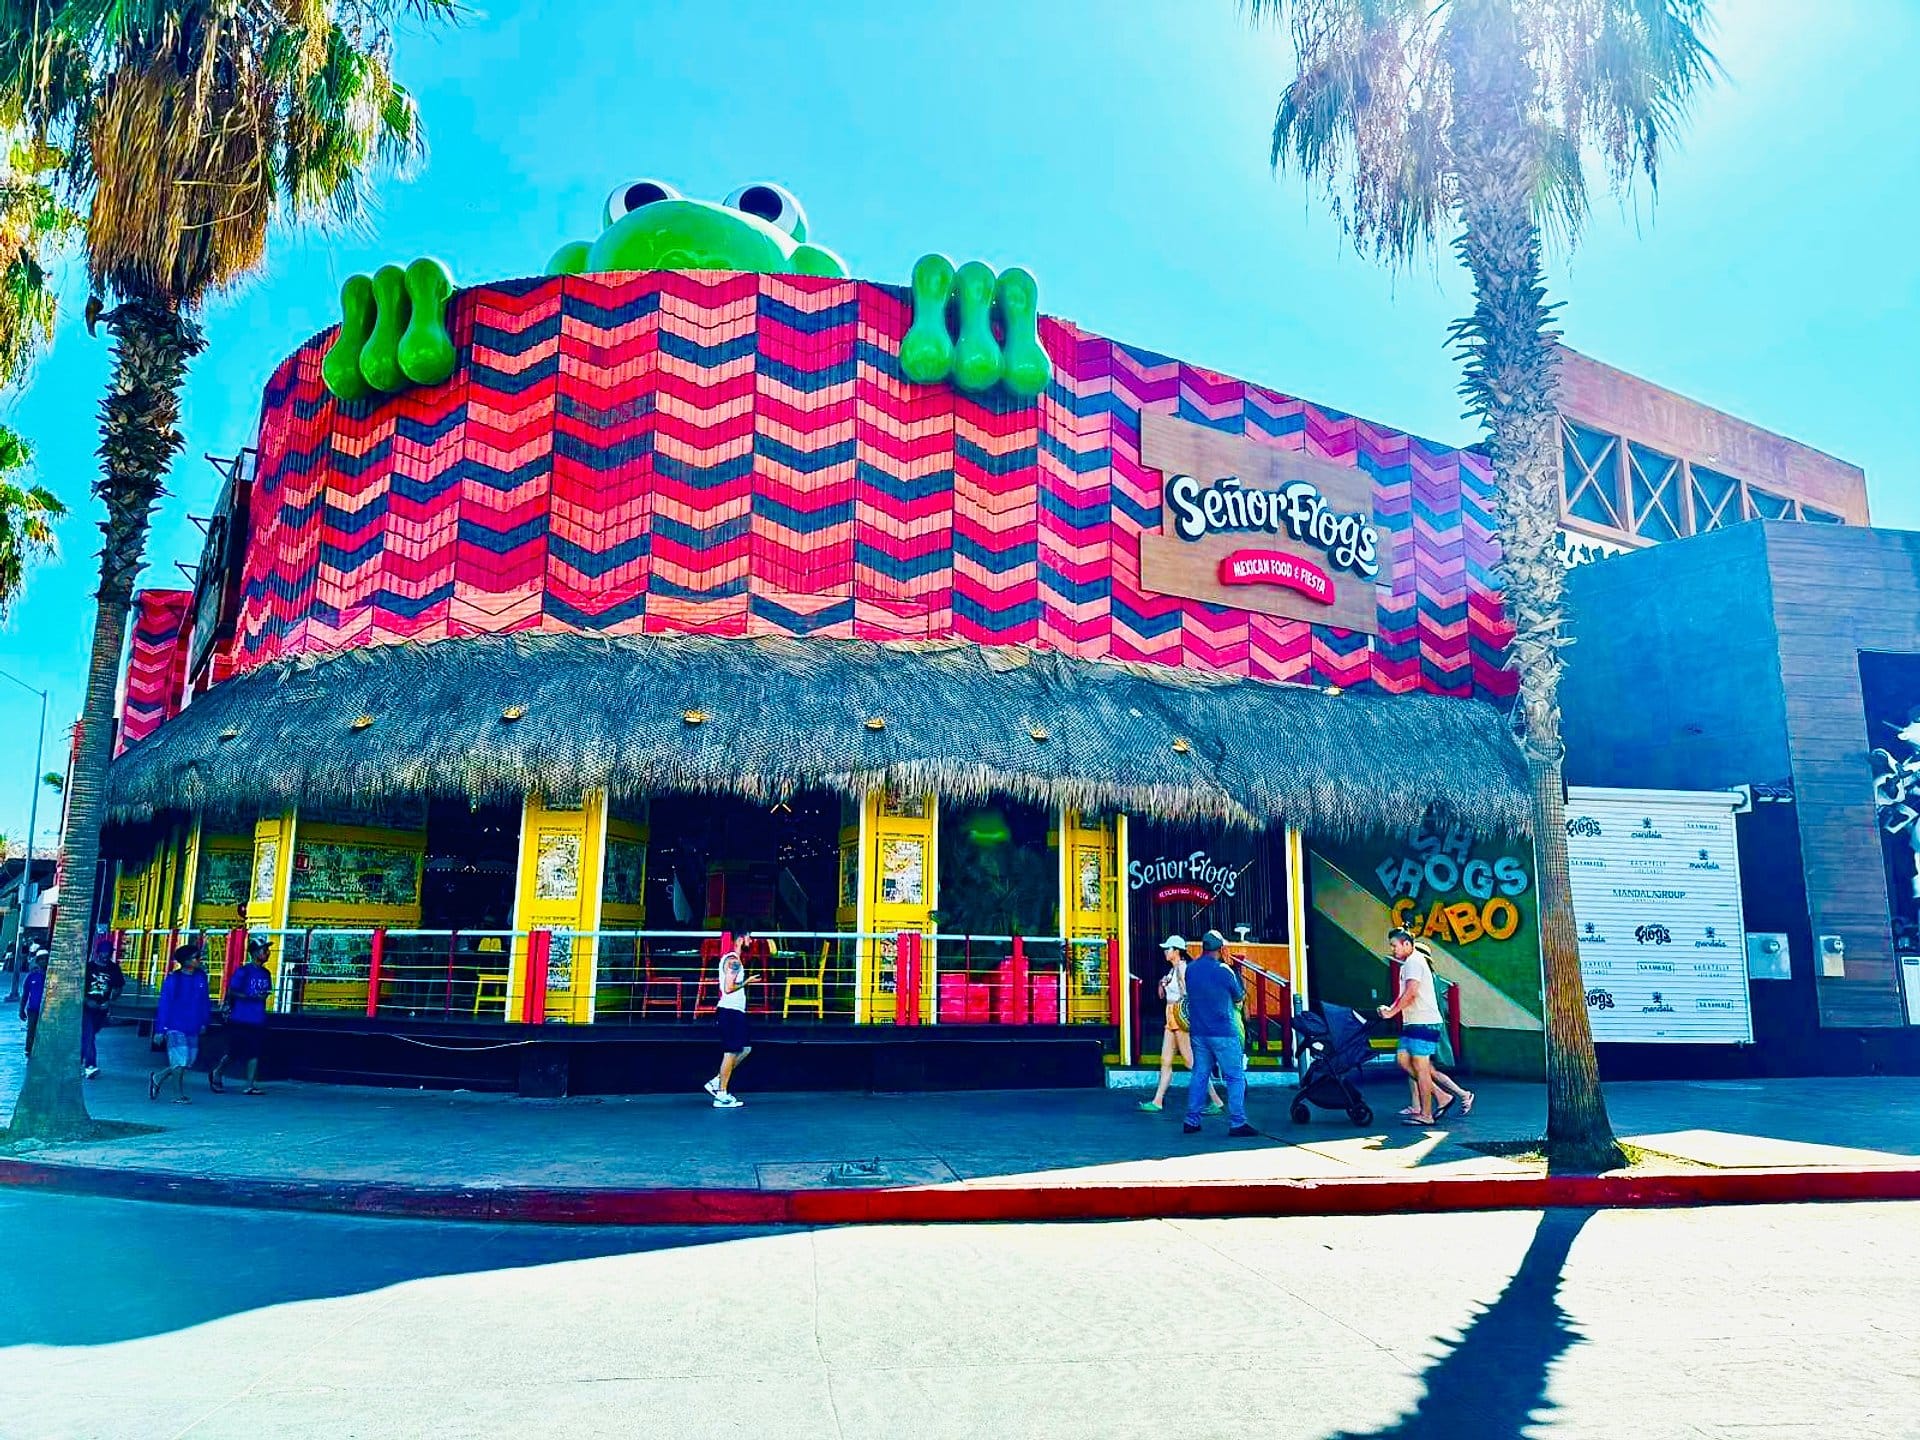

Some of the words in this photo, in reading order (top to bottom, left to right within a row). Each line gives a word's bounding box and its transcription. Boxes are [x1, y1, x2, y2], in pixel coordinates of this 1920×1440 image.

[1170, 475, 1287, 538] Señor
[1286, 482, 1379, 576] Frog's
[1233, 559, 1270, 577] MEXICAN
[1270, 559, 1293, 578] FOOD
[1300, 567, 1327, 595] FIESTA
[1129, 856, 1188, 890] Señor
[1188, 850, 1239, 897] Frog's
[1375, 854, 1529, 900] FROGS
